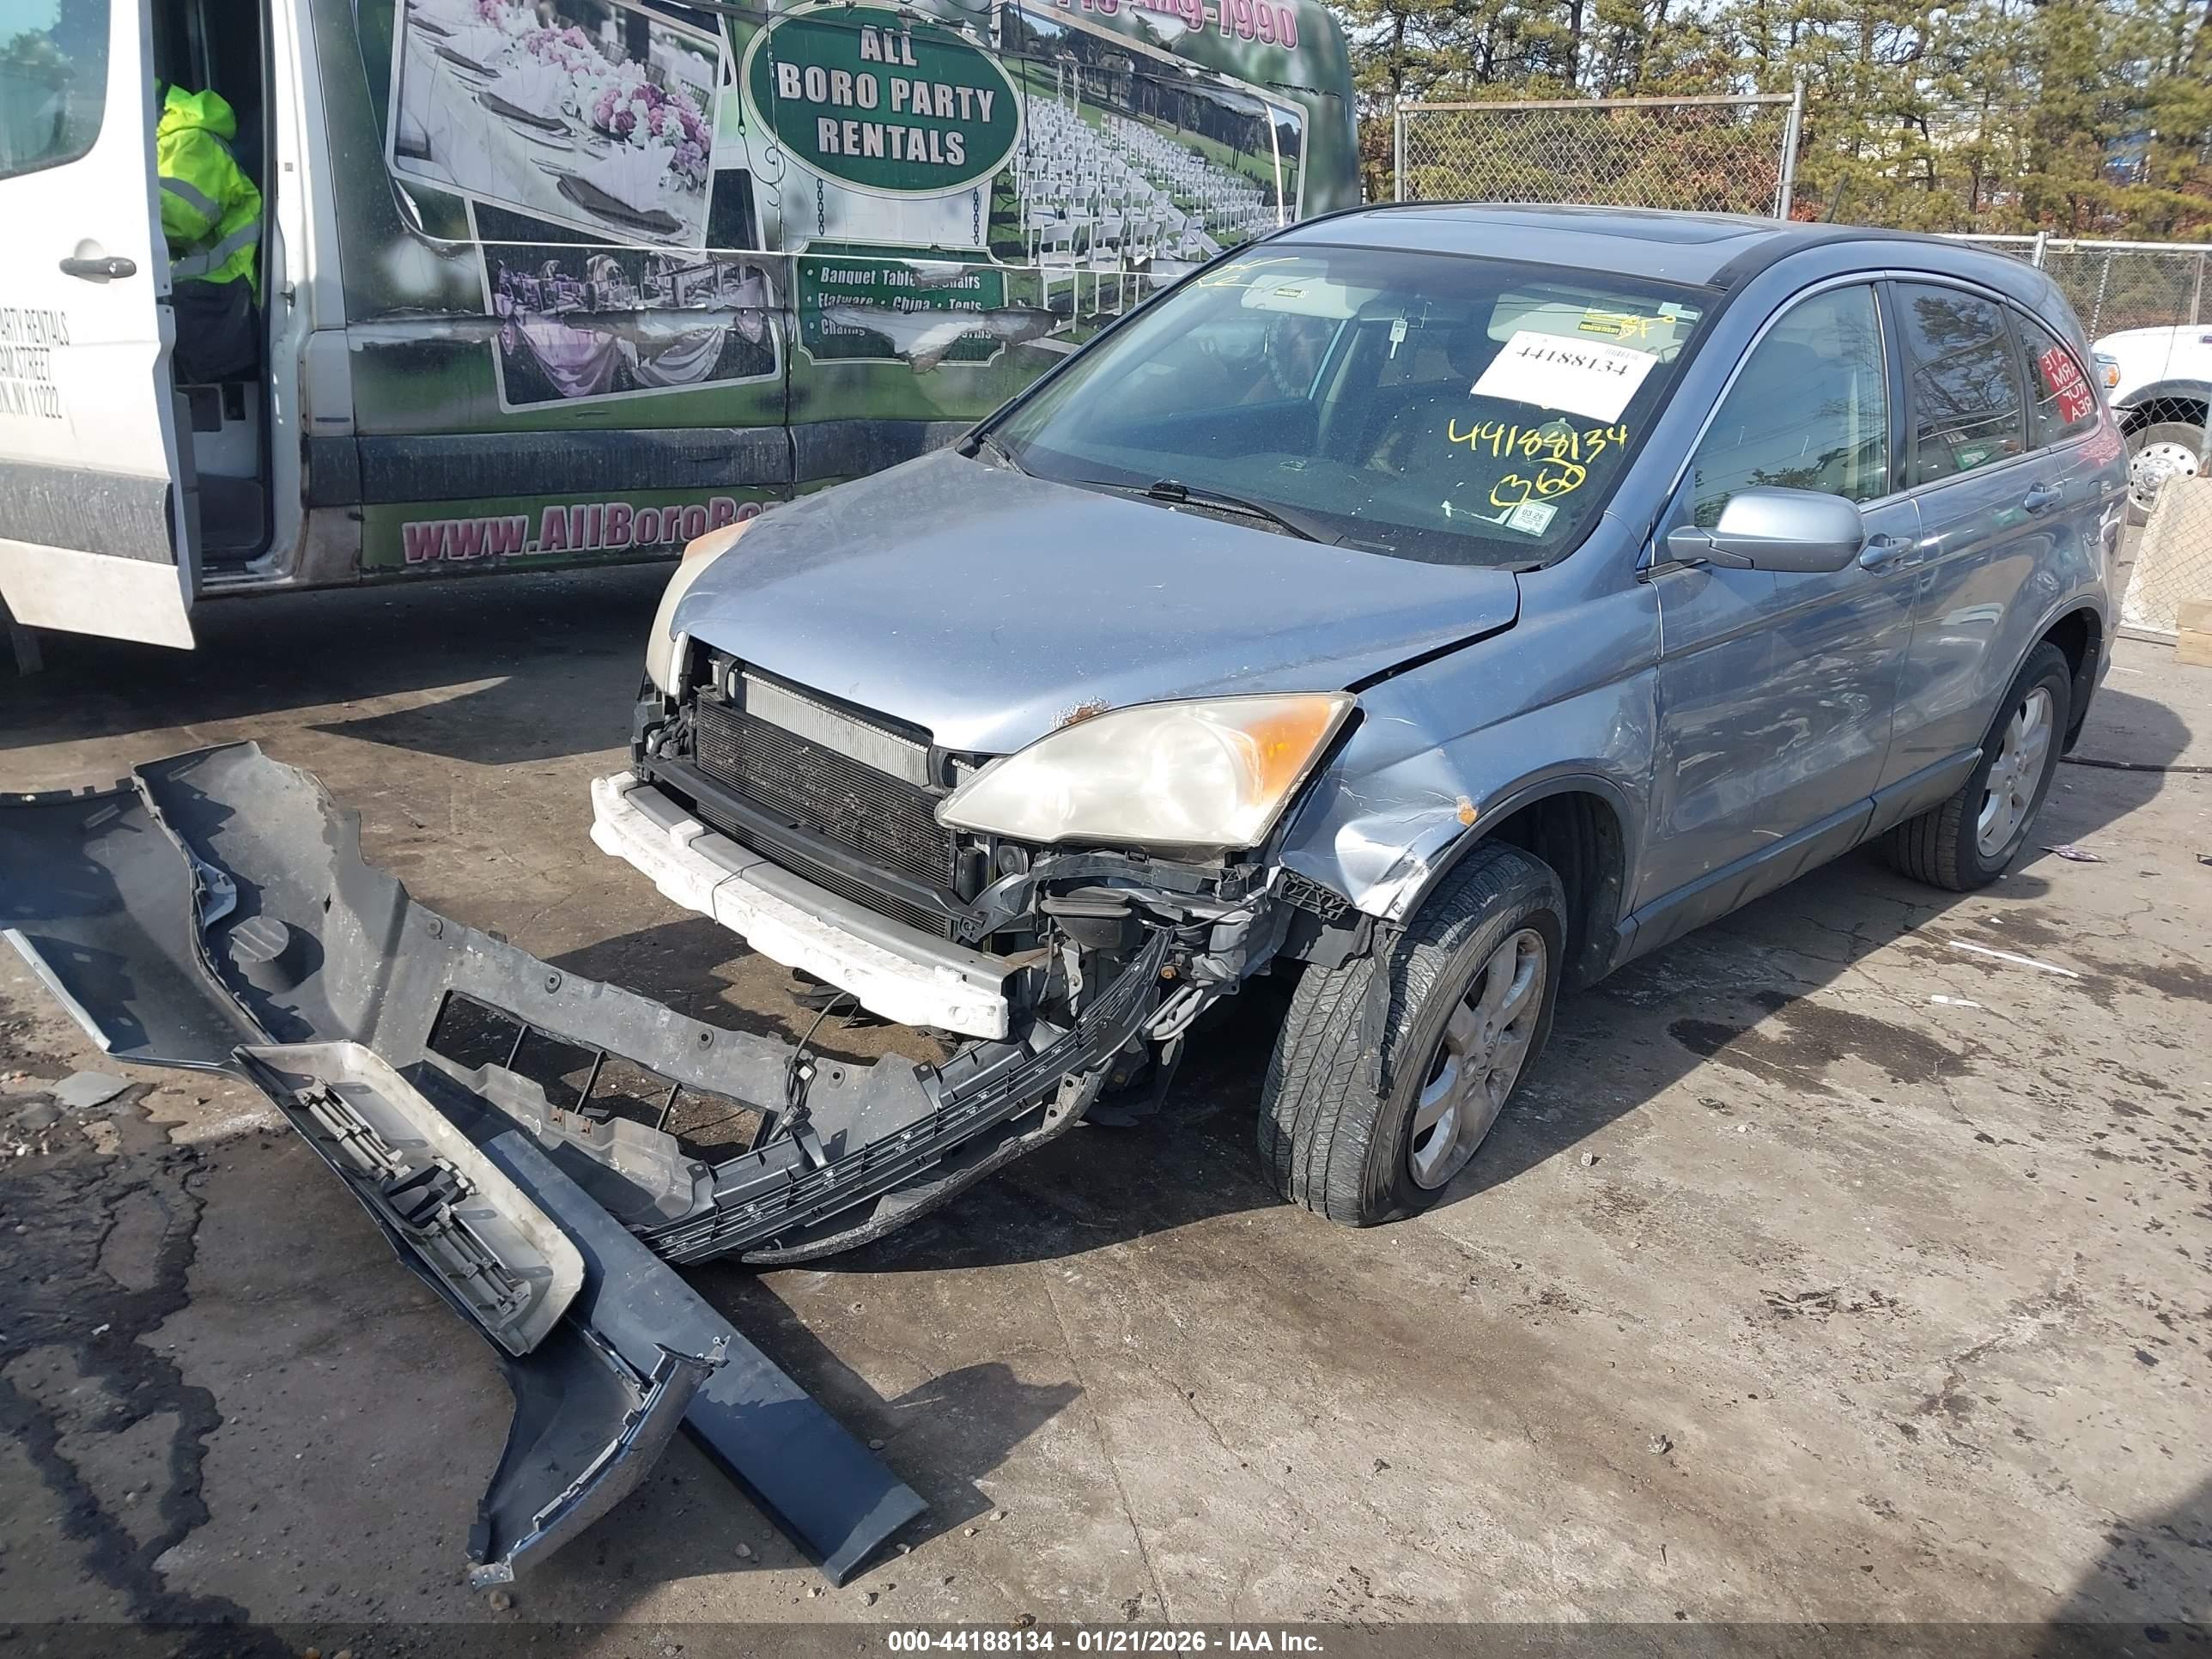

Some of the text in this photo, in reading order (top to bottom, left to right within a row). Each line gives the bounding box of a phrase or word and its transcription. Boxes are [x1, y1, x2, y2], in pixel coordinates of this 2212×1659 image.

[860, 23, 919, 67] ALL
[776, 61, 996, 123] BORO PARTY
[817, 116, 966, 166] RENTALS
[820, 266, 876, 286] Banquet
[892, 295, 931, 312] China
[949, 298, 982, 312] Tents
[24, 308, 69, 347] RENTALS
[15, 345, 51, 382] STREET
[1516, 346, 1628, 376] 44188134
[28, 384, 63, 420] 11222
